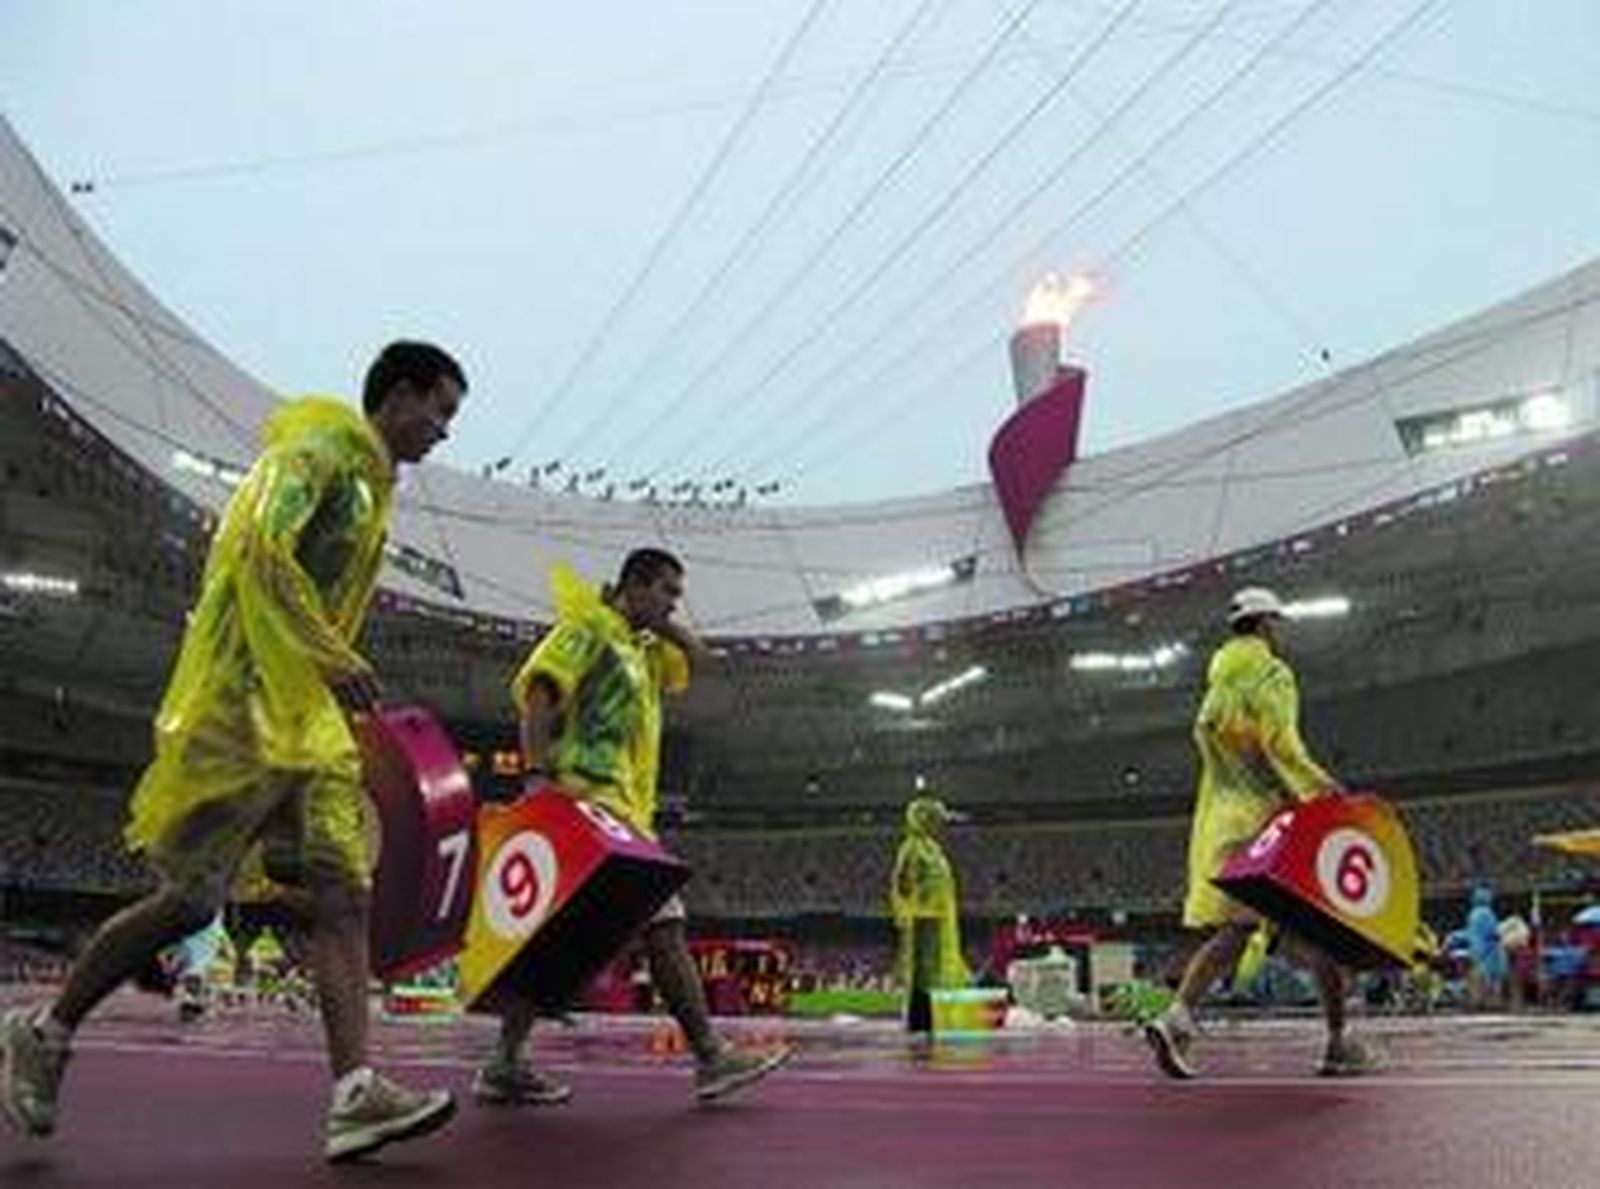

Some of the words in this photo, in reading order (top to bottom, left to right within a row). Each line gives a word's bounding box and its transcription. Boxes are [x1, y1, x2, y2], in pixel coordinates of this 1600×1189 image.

[438, 830, 470, 918] 7
[501, 852, 539, 918] 9
[1337, 843, 1375, 903] 6
